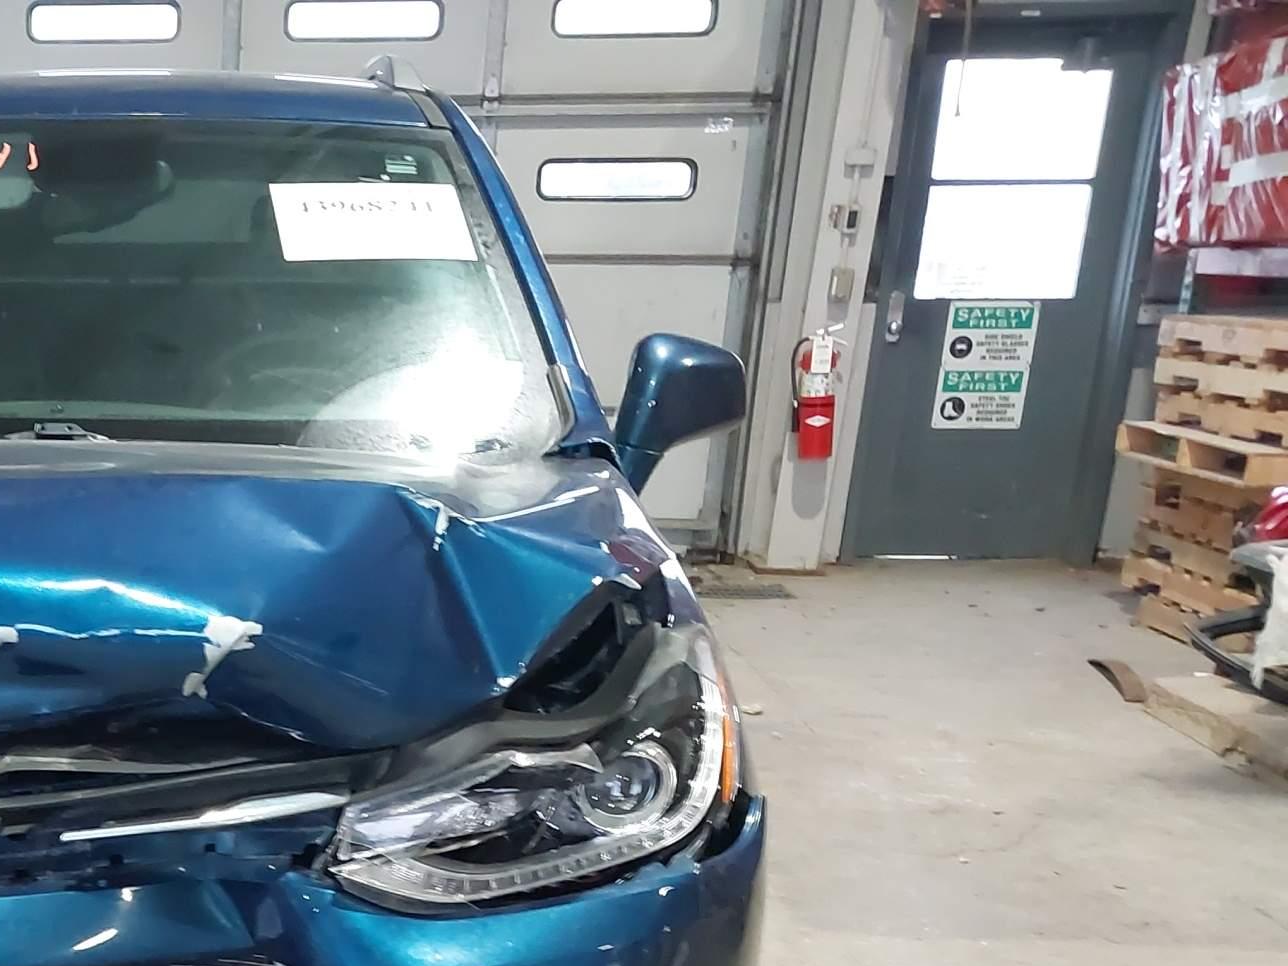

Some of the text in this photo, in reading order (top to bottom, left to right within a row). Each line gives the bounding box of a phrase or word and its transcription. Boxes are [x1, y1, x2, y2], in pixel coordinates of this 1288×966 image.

[957, 308, 1030, 322] SAFETY
[969, 319, 1019, 328] FIRST
[947, 372, 1020, 386] SAFETY
[959, 382, 1008, 391] FIRST
